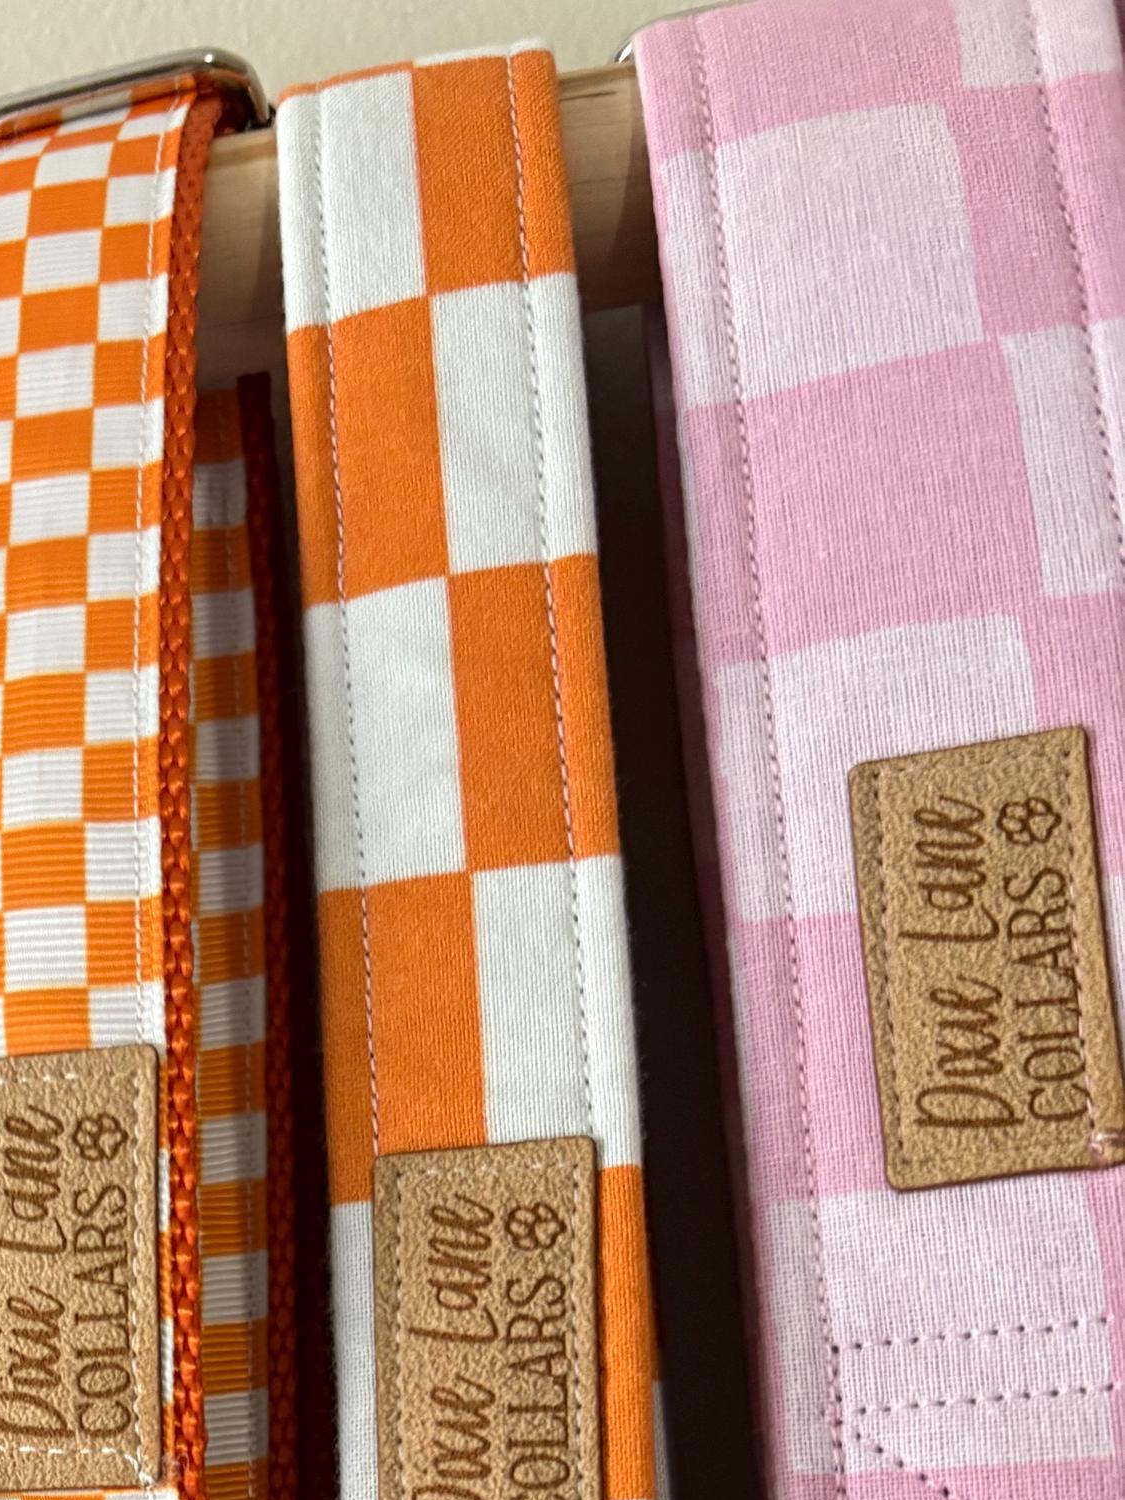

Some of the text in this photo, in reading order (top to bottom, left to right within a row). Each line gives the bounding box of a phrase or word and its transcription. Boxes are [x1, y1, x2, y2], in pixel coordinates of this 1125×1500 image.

[898, 795, 1024, 1129] Dixie Lane
[1003, 867, 1091, 1123] COLLARS
[75, 1184, 131, 1439] COLLARS
[408, 1193, 499, 1343] Lane
